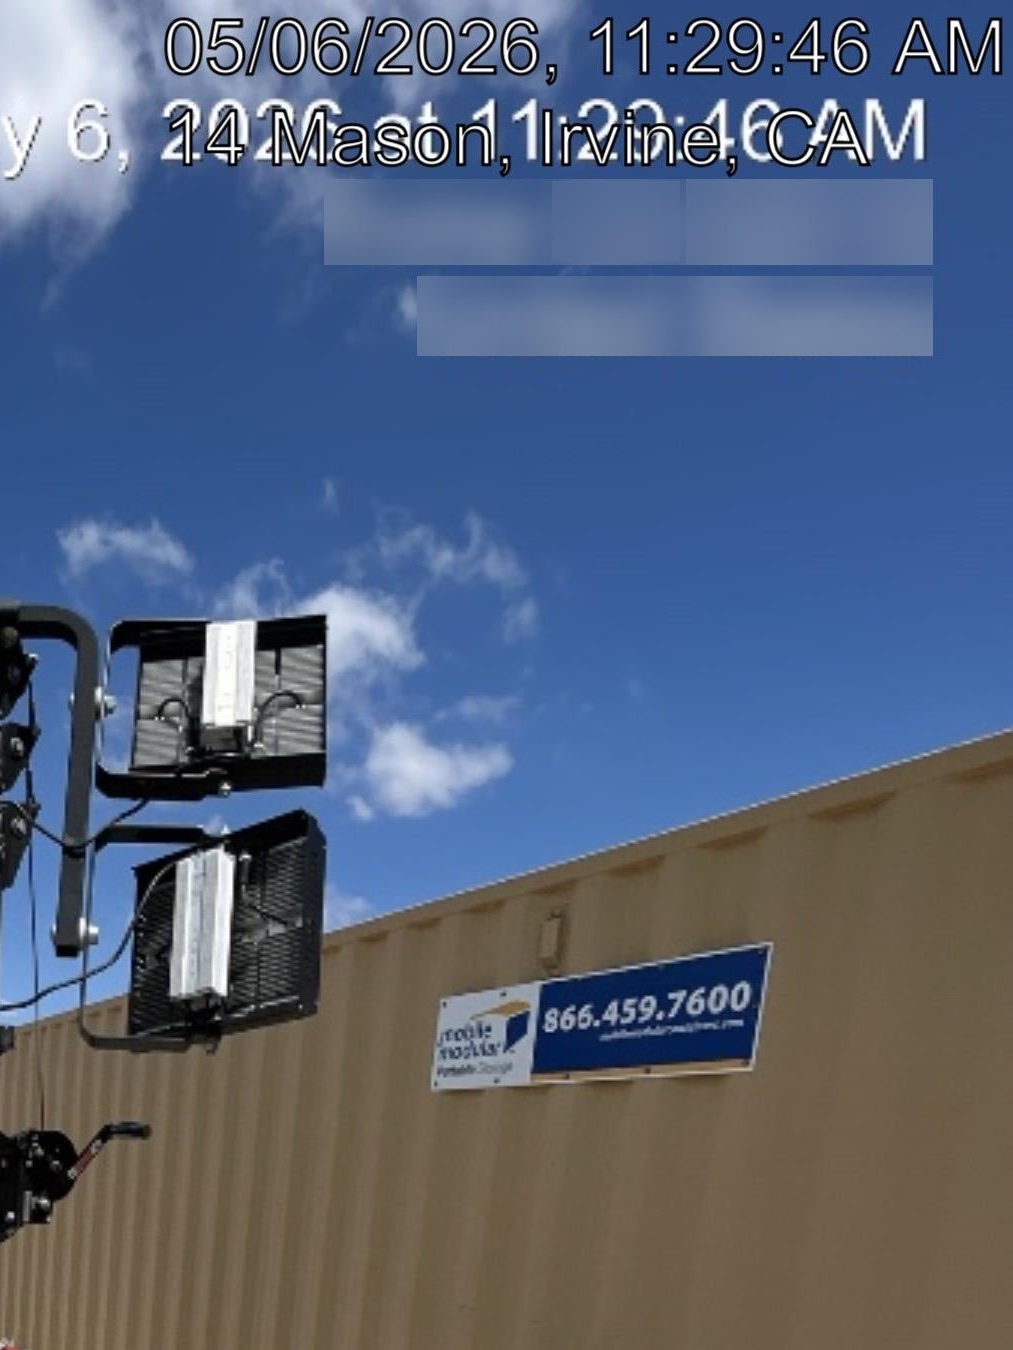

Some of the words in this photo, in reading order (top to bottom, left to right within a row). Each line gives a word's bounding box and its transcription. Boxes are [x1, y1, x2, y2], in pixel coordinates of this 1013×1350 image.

[542, 980, 752, 1033] 866.459.7600
[436, 1021, 493, 1047] mobile
[439, 1040, 501, 1060] modular
